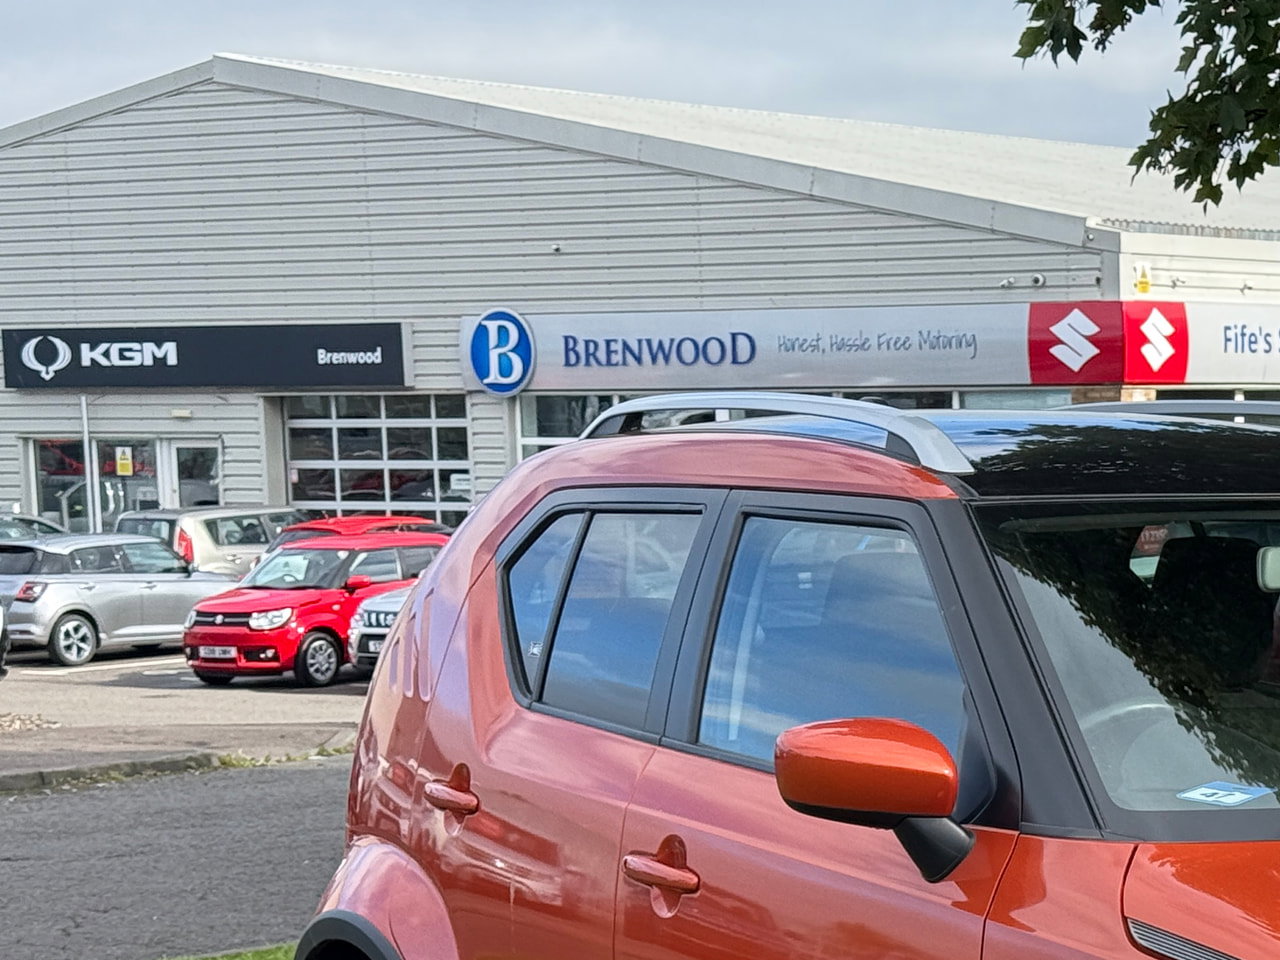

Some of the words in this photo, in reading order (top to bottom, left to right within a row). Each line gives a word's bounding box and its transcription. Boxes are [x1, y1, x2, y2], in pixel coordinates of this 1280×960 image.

[81, 341, 178, 367] KGM
[481, 319, 524, 385] B
[562, 332, 757, 368] BRENWOOD
[777, 331, 826, 354] Honest,
[829, 329, 872, 352] Hassle
[877, 332, 912, 352] Free
[918, 329, 978, 360] Motoring
[1223, 324, 1273, 354] Fife's
[317, 346, 382, 365] Brenwood
